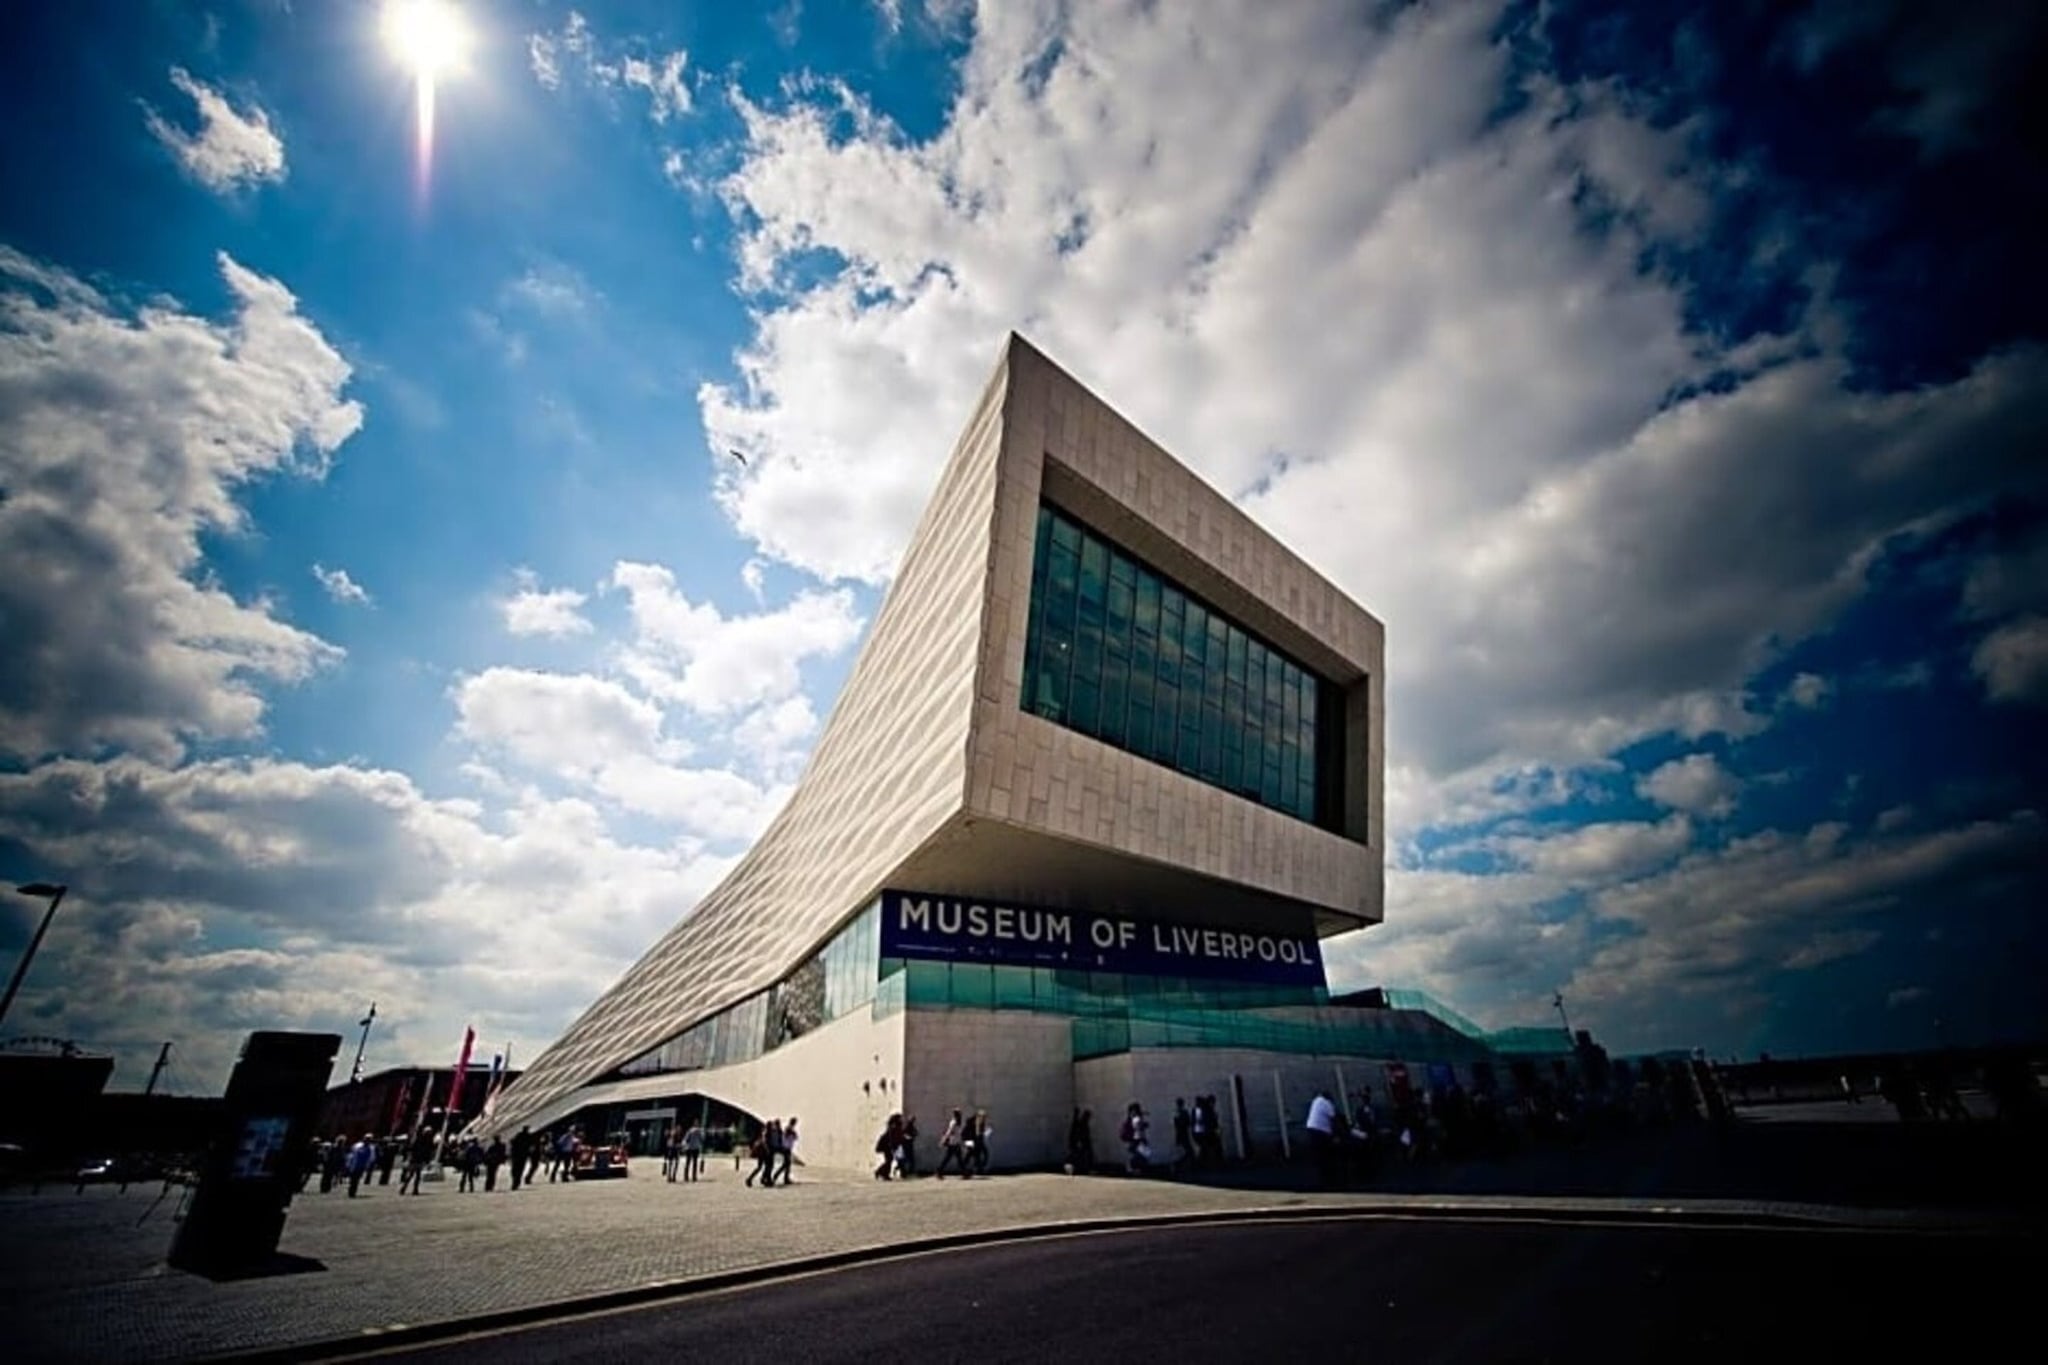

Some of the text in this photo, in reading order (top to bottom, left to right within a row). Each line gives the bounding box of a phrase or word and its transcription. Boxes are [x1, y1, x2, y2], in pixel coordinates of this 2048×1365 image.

[899, 897, 1315, 966] MUSEUM OF LIVERPOOL
